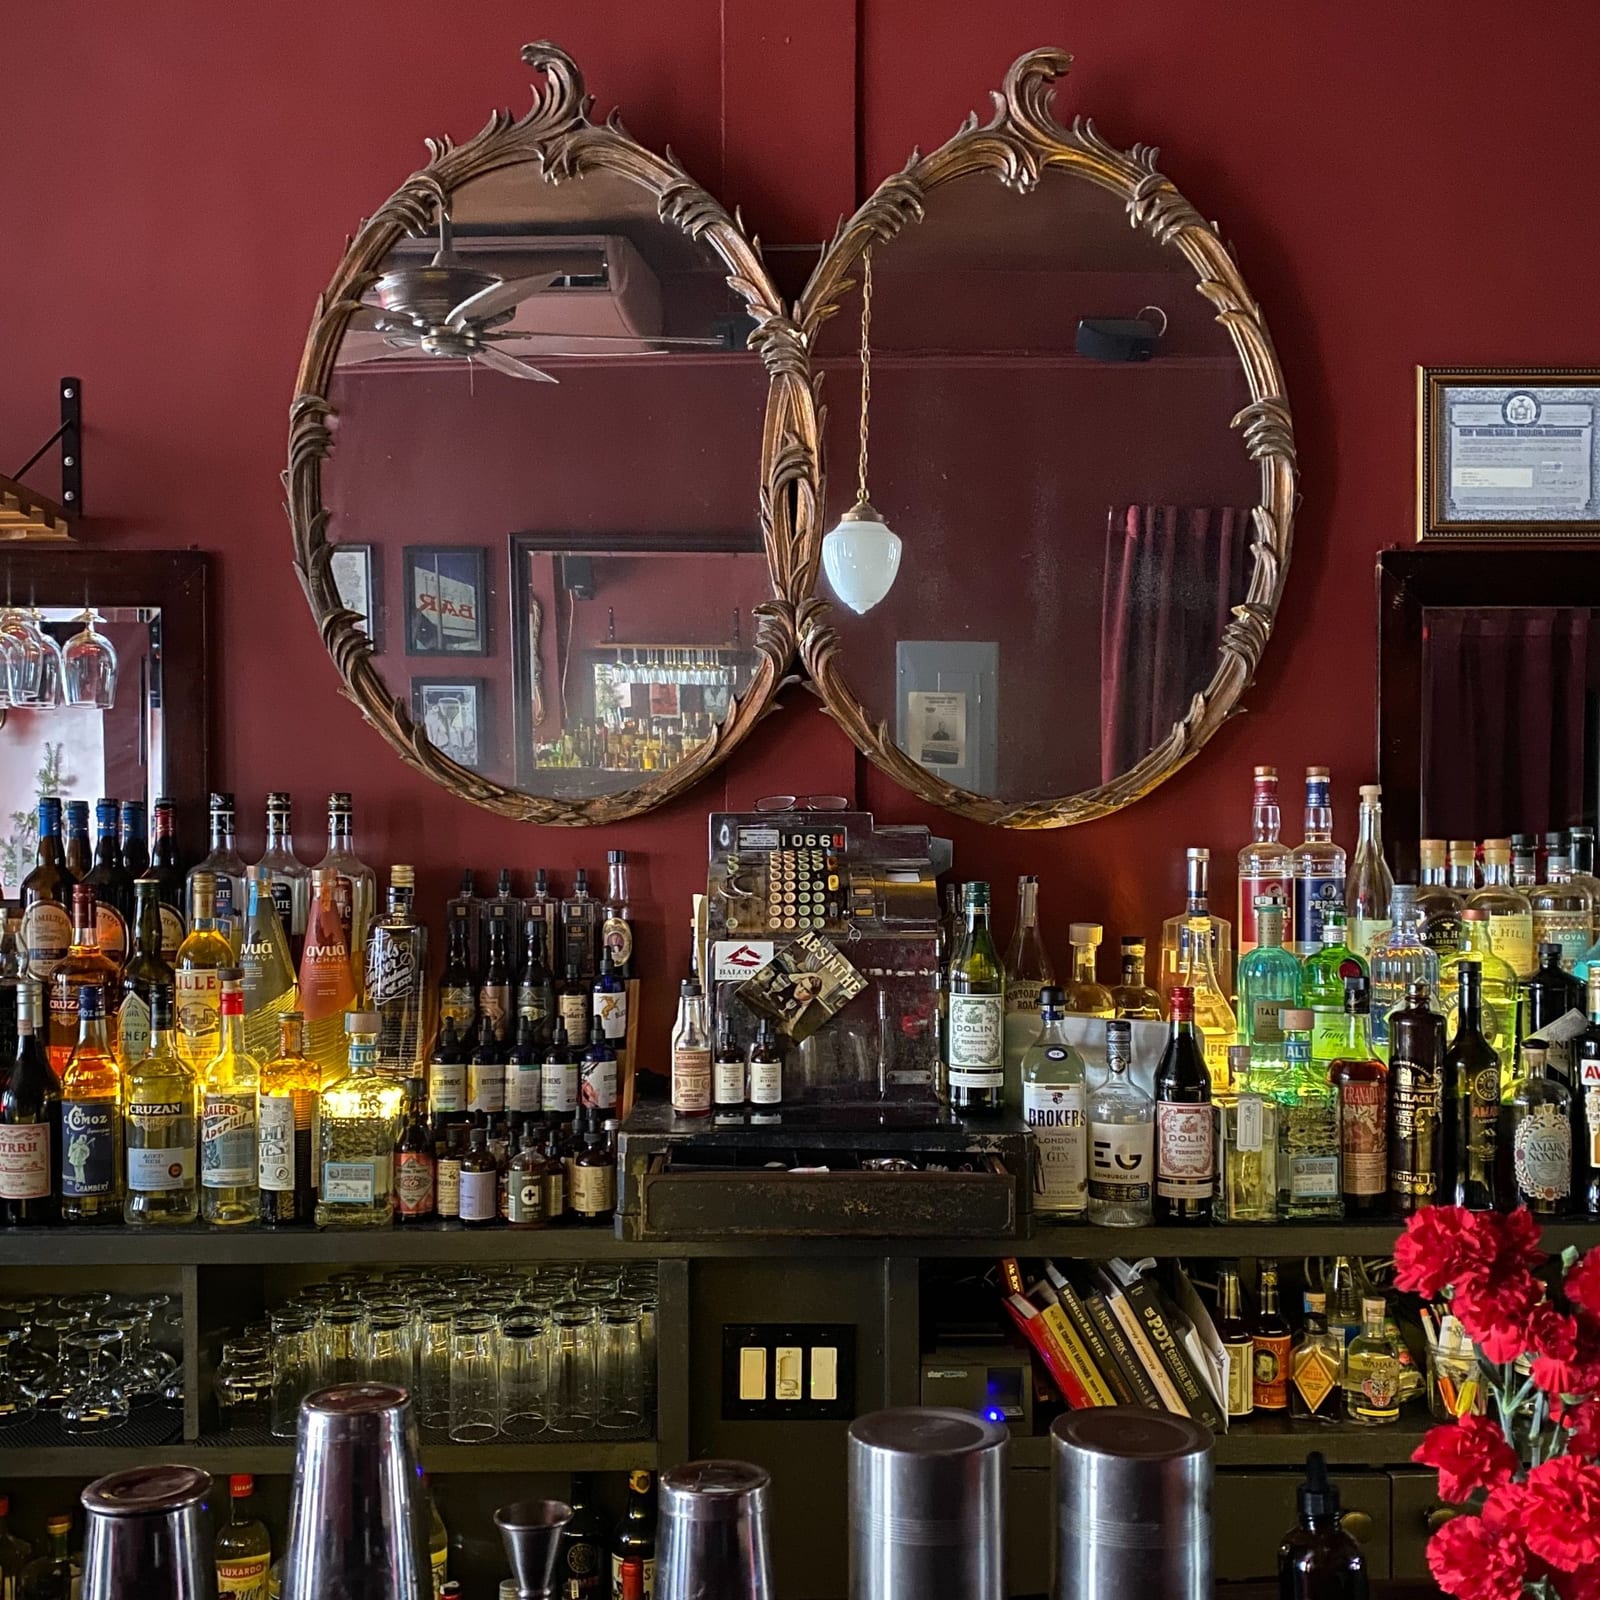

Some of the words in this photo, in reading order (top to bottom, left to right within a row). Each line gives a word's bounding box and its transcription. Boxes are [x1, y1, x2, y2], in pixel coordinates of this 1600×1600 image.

[240, 939, 274, 955] vuá
[306, 941, 346, 957] avuá
[795, 931, 862, 995] ABSINTHE
[175, 975, 223, 990] ILLE
[49, 1000, 80, 1009] CRUZ
[1257, 1007, 1281, 1016] ITALI
[956, 1024, 993, 1033] DOLIN
[1584, 1065, 1600, 1079] AV
[1400, 1092, 1433, 1104] BLACK
[129, 1103, 181, 1115] CRUZAN
[1038, 1137, 1078, 1145] LONDON
[1168, 1134, 1207, 1143] DOLIN
[0, 1142, 38, 1153] YRRH
[1062, 1288, 1086, 1323] BROOKLYN
[1082, 1321, 1095, 1338] BAR
[1091, 1336, 1106, 1358] BITES
[1098, 1309, 1116, 1332] NEW
[1110, 1330, 1128, 1356] YORK
[1147, 1314, 1176, 1351] PDT
[1166, 1346, 1190, 1383] COCKTAIL
[221, 1563, 263, 1577] LUXARDO
